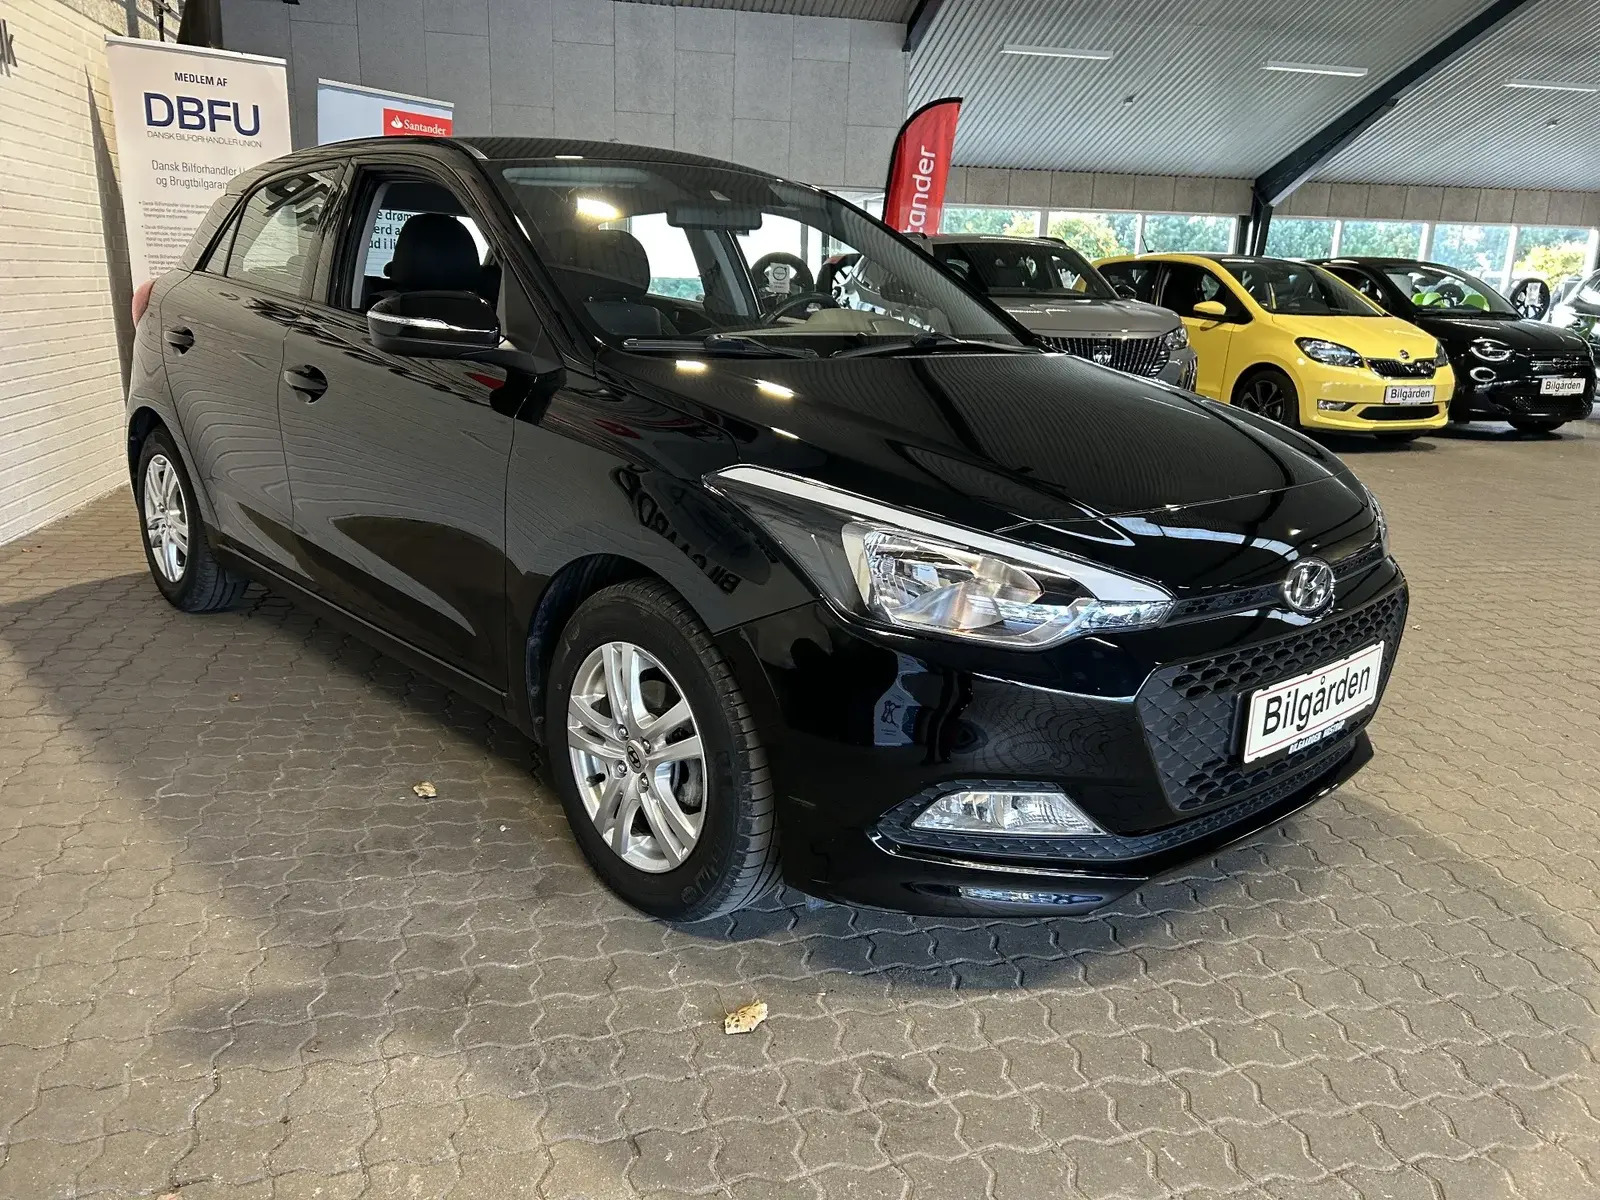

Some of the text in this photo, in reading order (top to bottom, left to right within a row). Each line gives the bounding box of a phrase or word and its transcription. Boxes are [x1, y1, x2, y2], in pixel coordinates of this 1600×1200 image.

[174, 72, 228, 87] MEDLEM AF
[144, 92, 260, 137] DBFU
[404, 119, 447, 135] Santander
[147, 130, 262, 148] DANSK BILFORHANDLER UNION
[151, 159, 180, 172] Dansk
[181, 162, 237, 176] Bilforhandler
[156, 177, 168, 187] og
[1390, 388, 1430, 400] Bilgården
[1545, 381, 1581, 392] Bilgården
[1262, 666, 1371, 737] Bilgården
